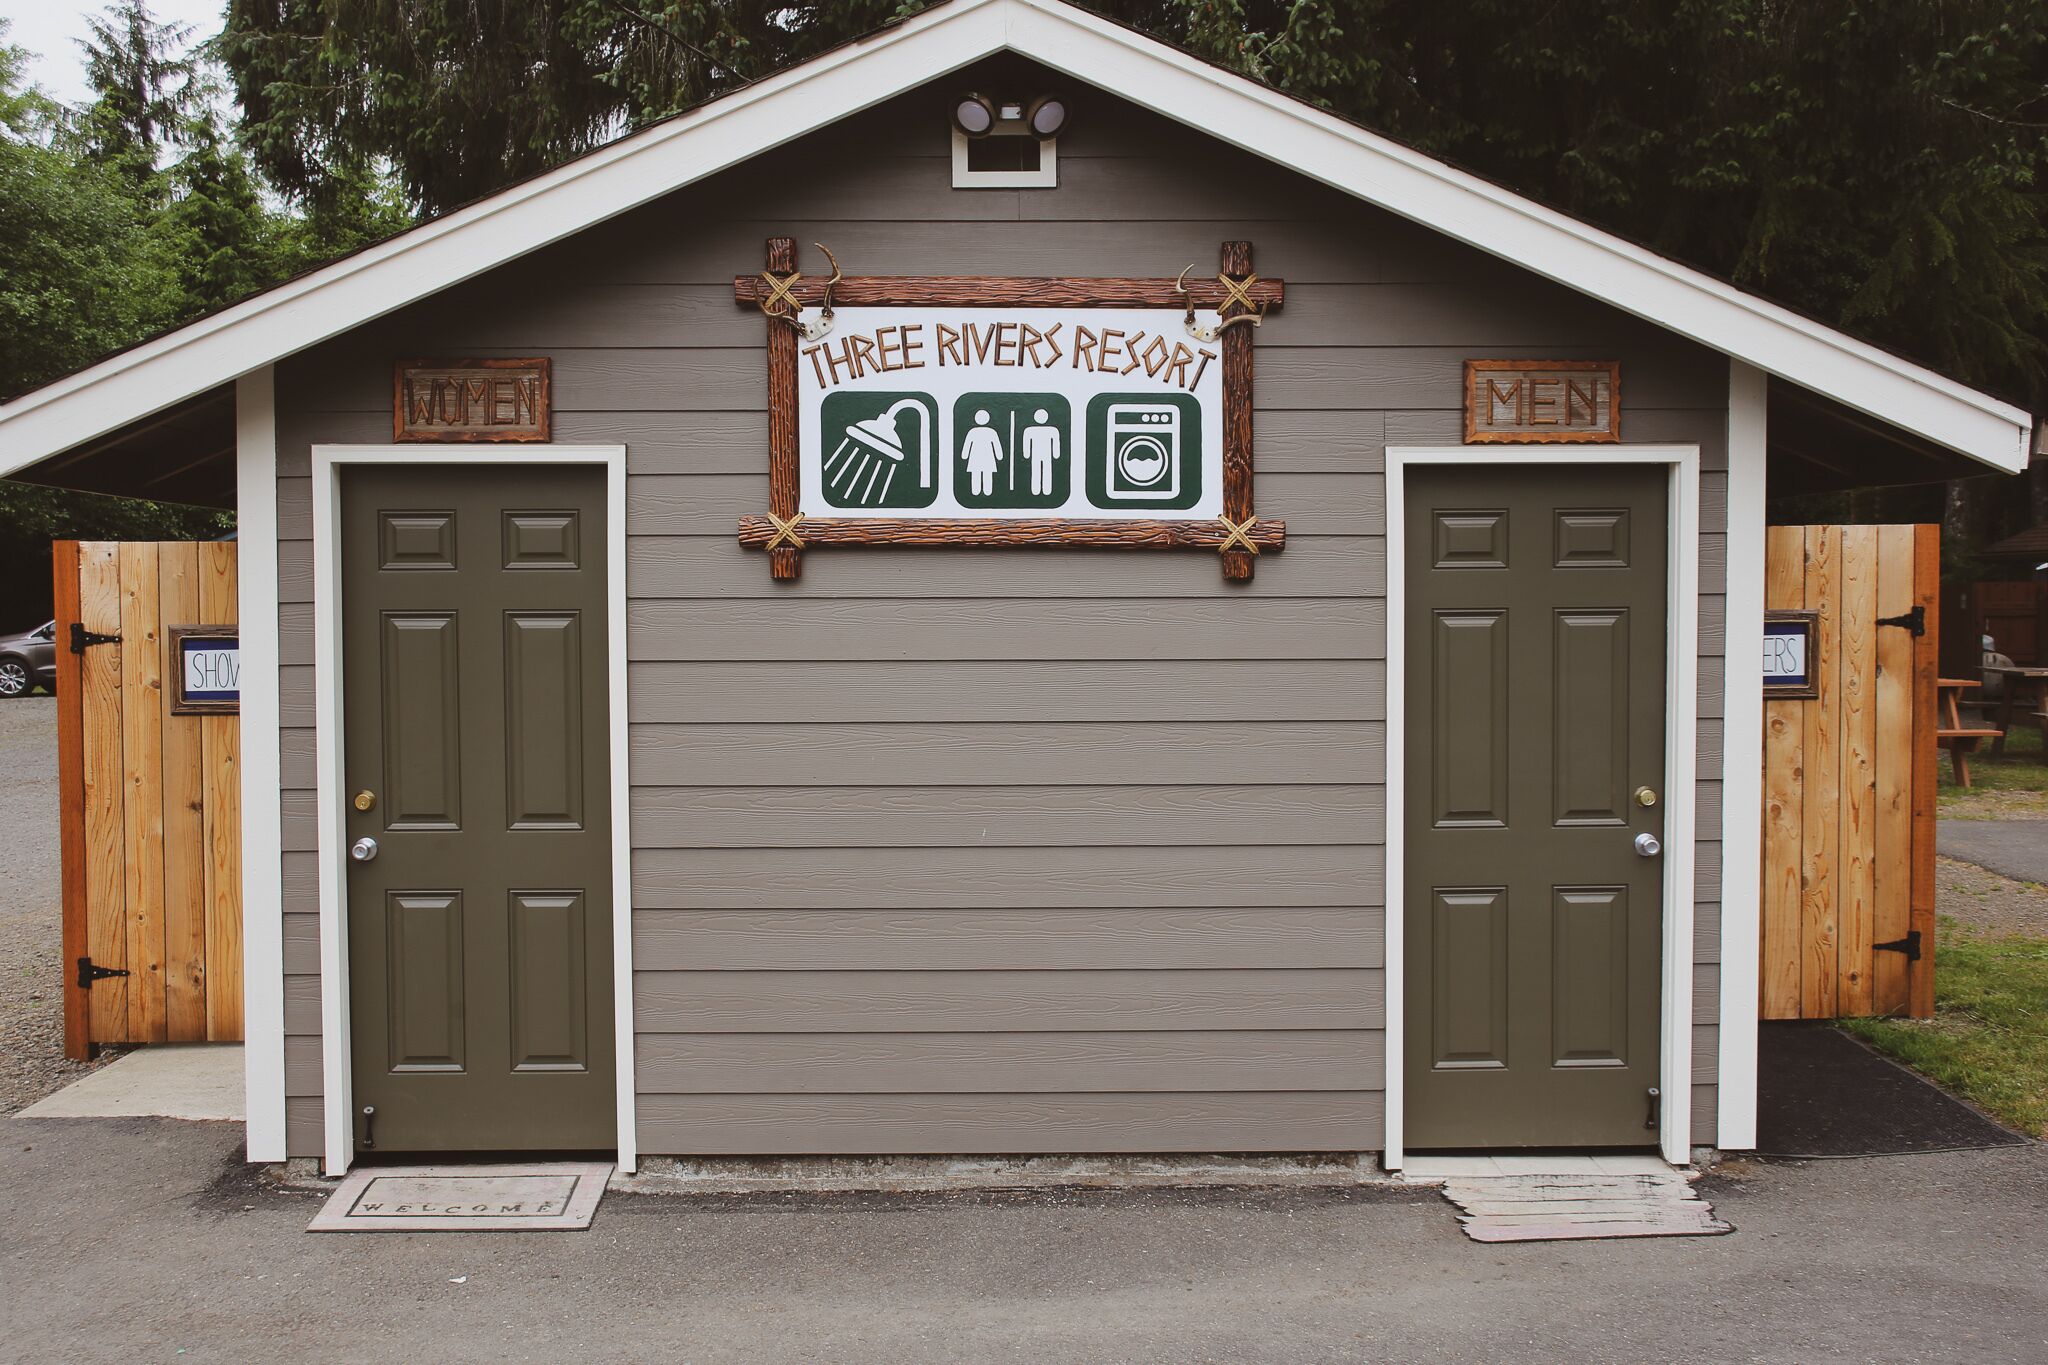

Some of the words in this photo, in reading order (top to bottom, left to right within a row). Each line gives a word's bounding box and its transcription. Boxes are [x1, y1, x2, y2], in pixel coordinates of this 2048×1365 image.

[802, 324, 925, 389] THREE
[936, 322, 1062, 368] RIVERS
[1072, 325, 1218, 392] RESORT
[407, 376, 536, 425] WOMEN
[1486, 378, 1597, 426] MEN
[1762, 637, 1797, 674] ERS
[362, 1201, 554, 1214] WELCOME
